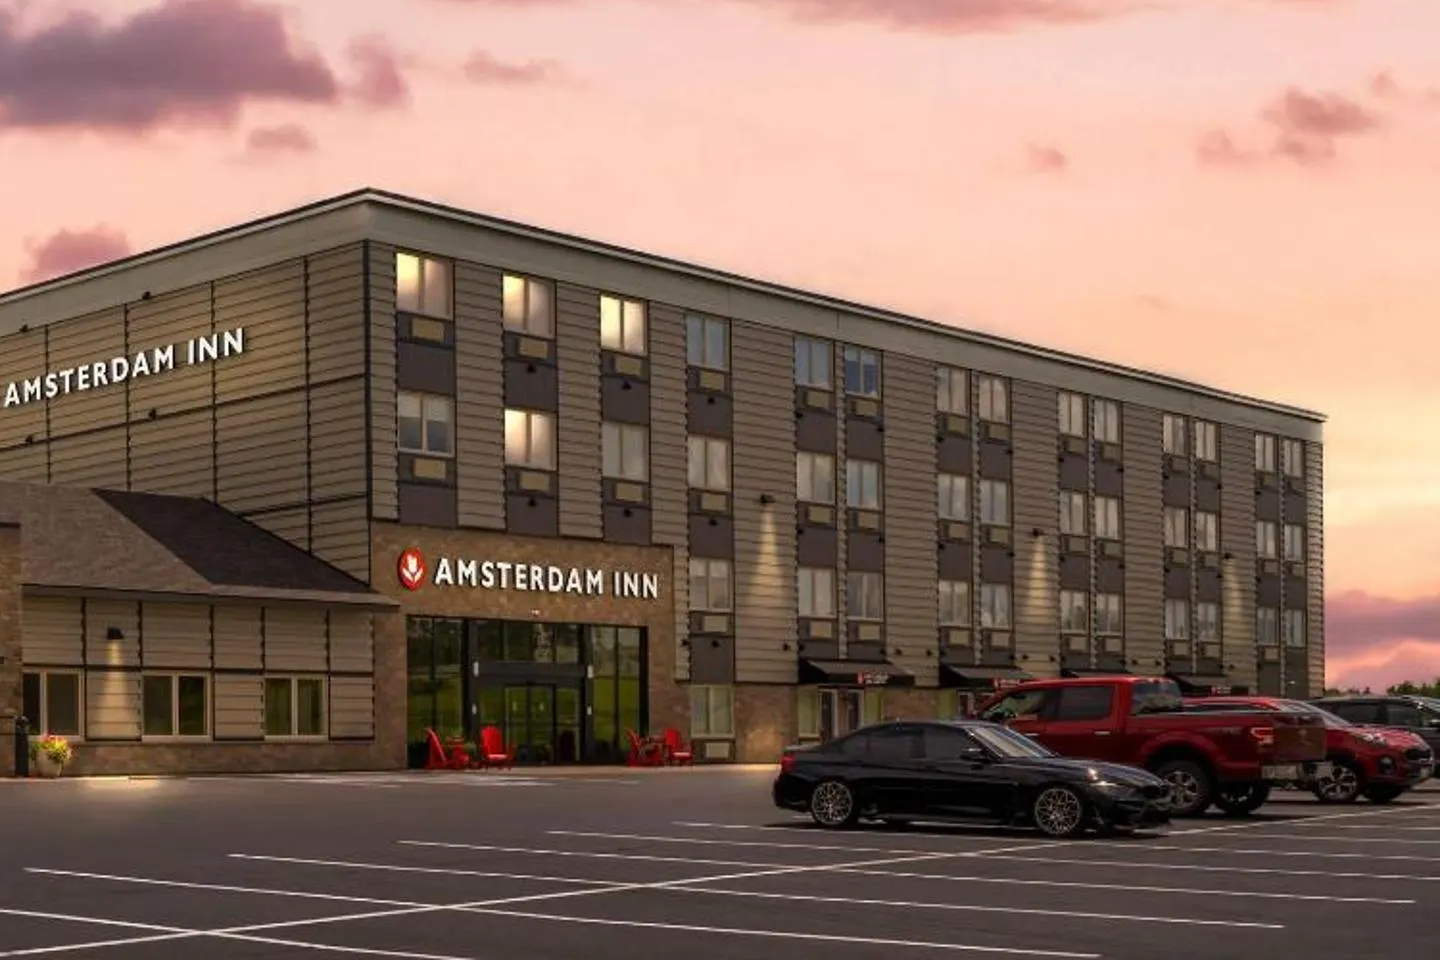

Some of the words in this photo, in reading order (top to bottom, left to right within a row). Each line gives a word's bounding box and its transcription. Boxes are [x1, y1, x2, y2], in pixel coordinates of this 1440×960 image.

[3, 344, 174, 408] AMSTERDAM
[187, 327, 243, 365] INN
[435, 557, 603, 595] AMSTERDAM
[614, 571, 658, 599] INN
